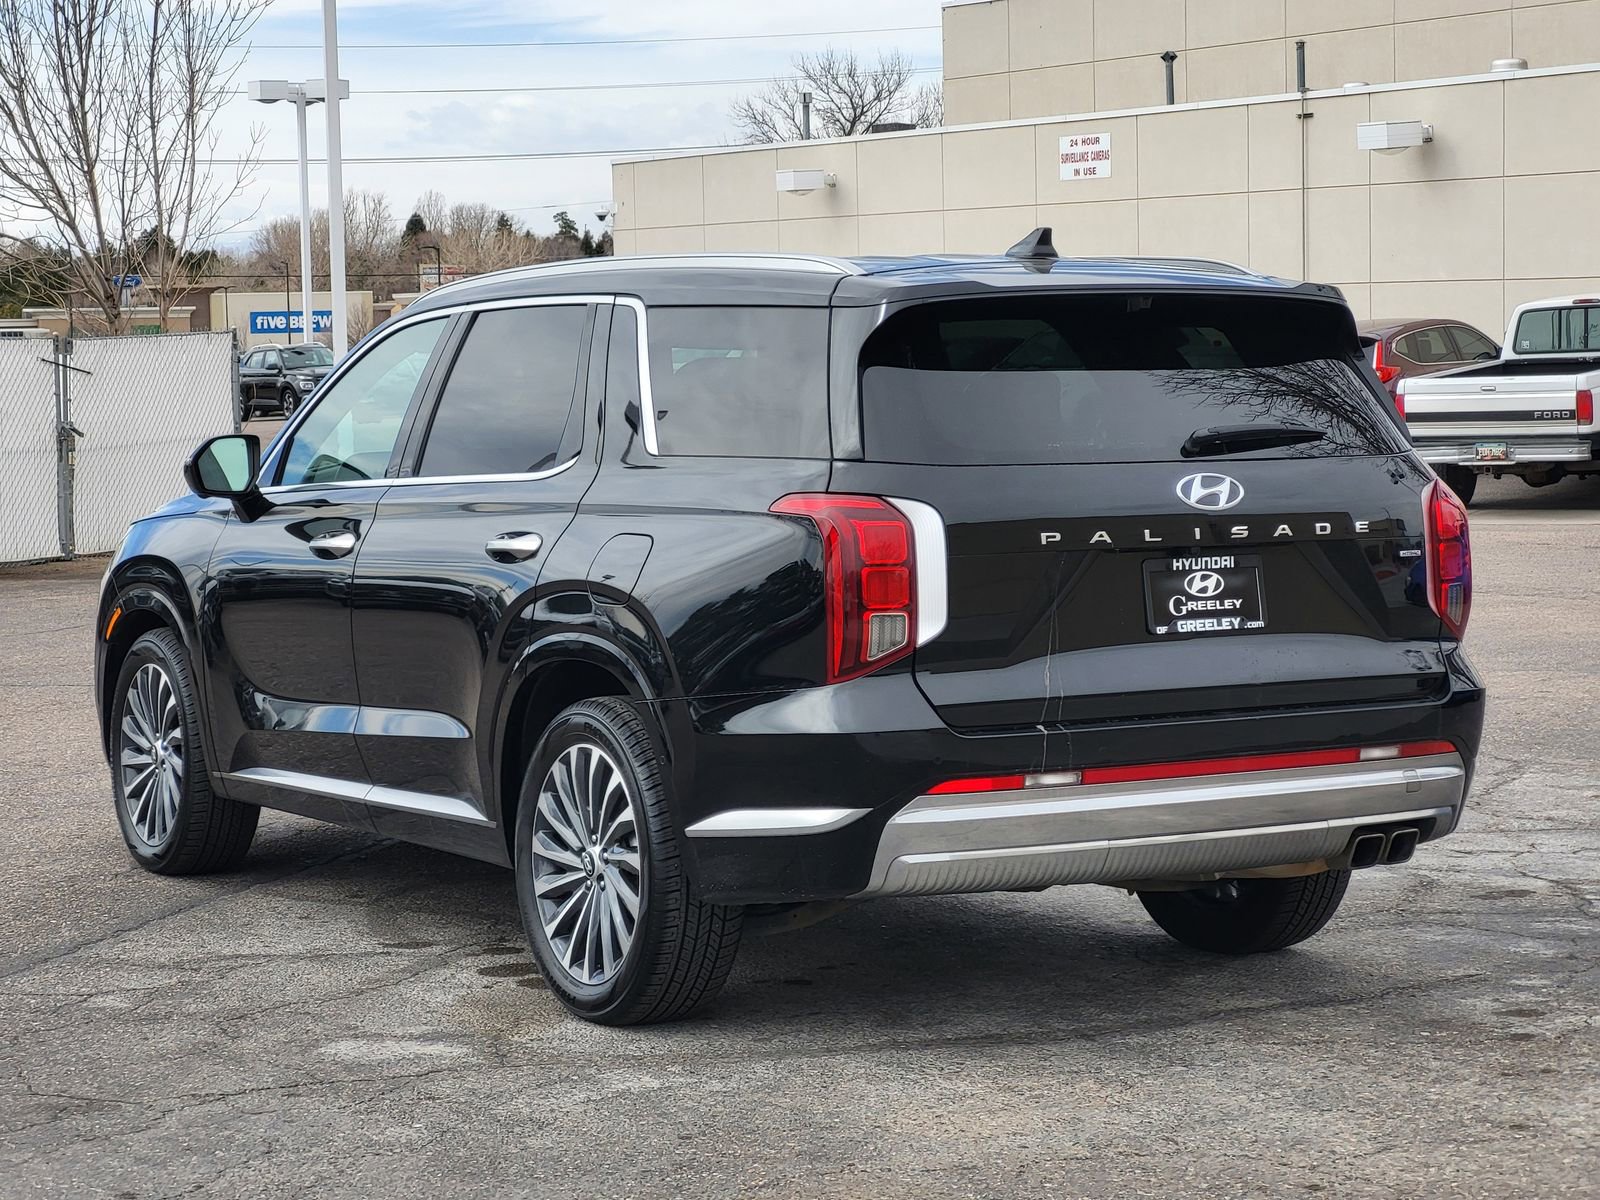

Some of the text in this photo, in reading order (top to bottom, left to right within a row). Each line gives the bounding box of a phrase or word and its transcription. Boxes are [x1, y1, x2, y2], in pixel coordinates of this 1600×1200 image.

[1070, 137, 1100, 147] 24 HOUR
[1090, 149, 1110, 162] CAMERAS
[1073, 167, 1096, 176] IN USE
[256, 315, 287, 329] five
[1534, 411, 1570, 419] FORD
[1040, 521, 1370, 545] PALISADE
[1172, 556, 1235, 571] HYUNDAI
[1169, 595, 1243, 616] GREELEY
[1156, 617, 1265, 635] OF GREELEY .com
